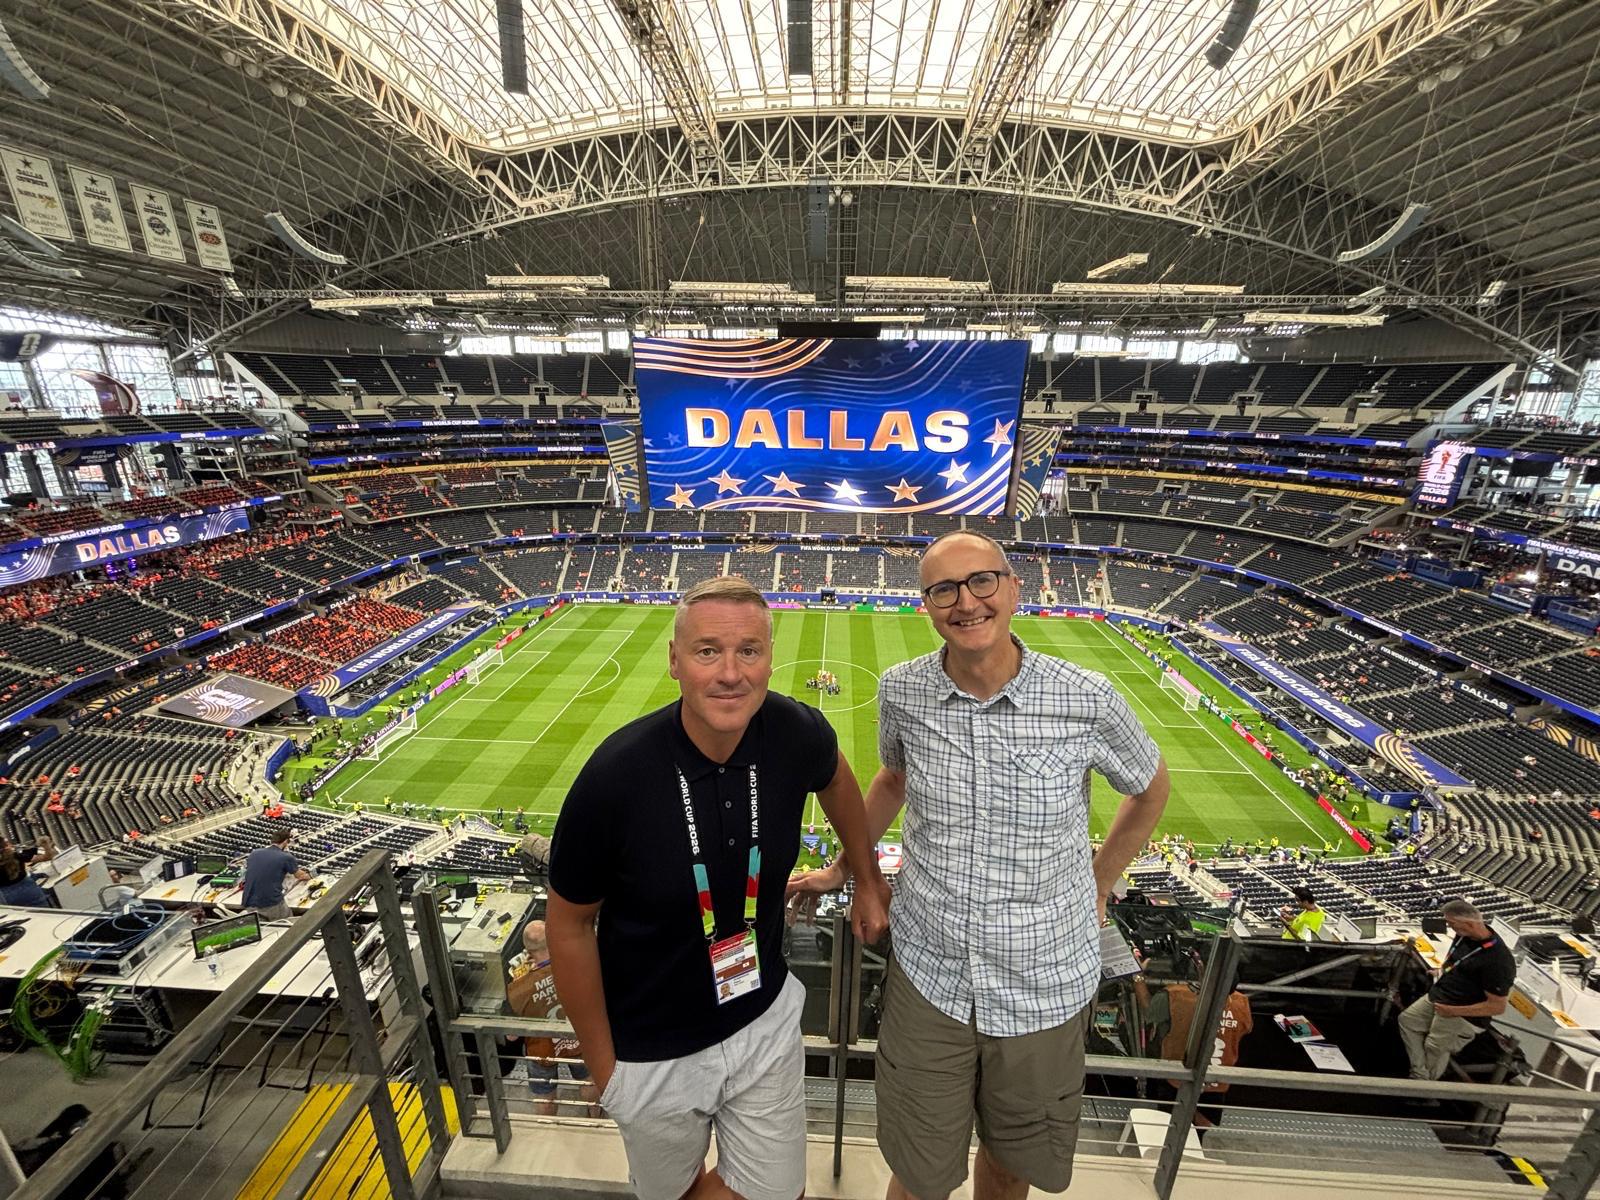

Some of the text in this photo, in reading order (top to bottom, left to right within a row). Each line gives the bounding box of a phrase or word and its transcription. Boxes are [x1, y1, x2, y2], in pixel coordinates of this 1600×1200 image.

[685, 407, 970, 453] DALLAS
[76, 526, 181, 563] DALLAS
[1541, 542, 1564, 552] WORLD
[1334, 624, 1365, 642] DALLAS
[1235, 648, 1261, 661] FIFA
[1256, 660, 1297, 684] WORLD
[1460, 683, 1508, 710] DALLAS
[680, 775, 700, 856] WORLD CUP 2026
[750, 788, 758, 820] WORLD
[1331, 808, 1354, 836] Lenovo
